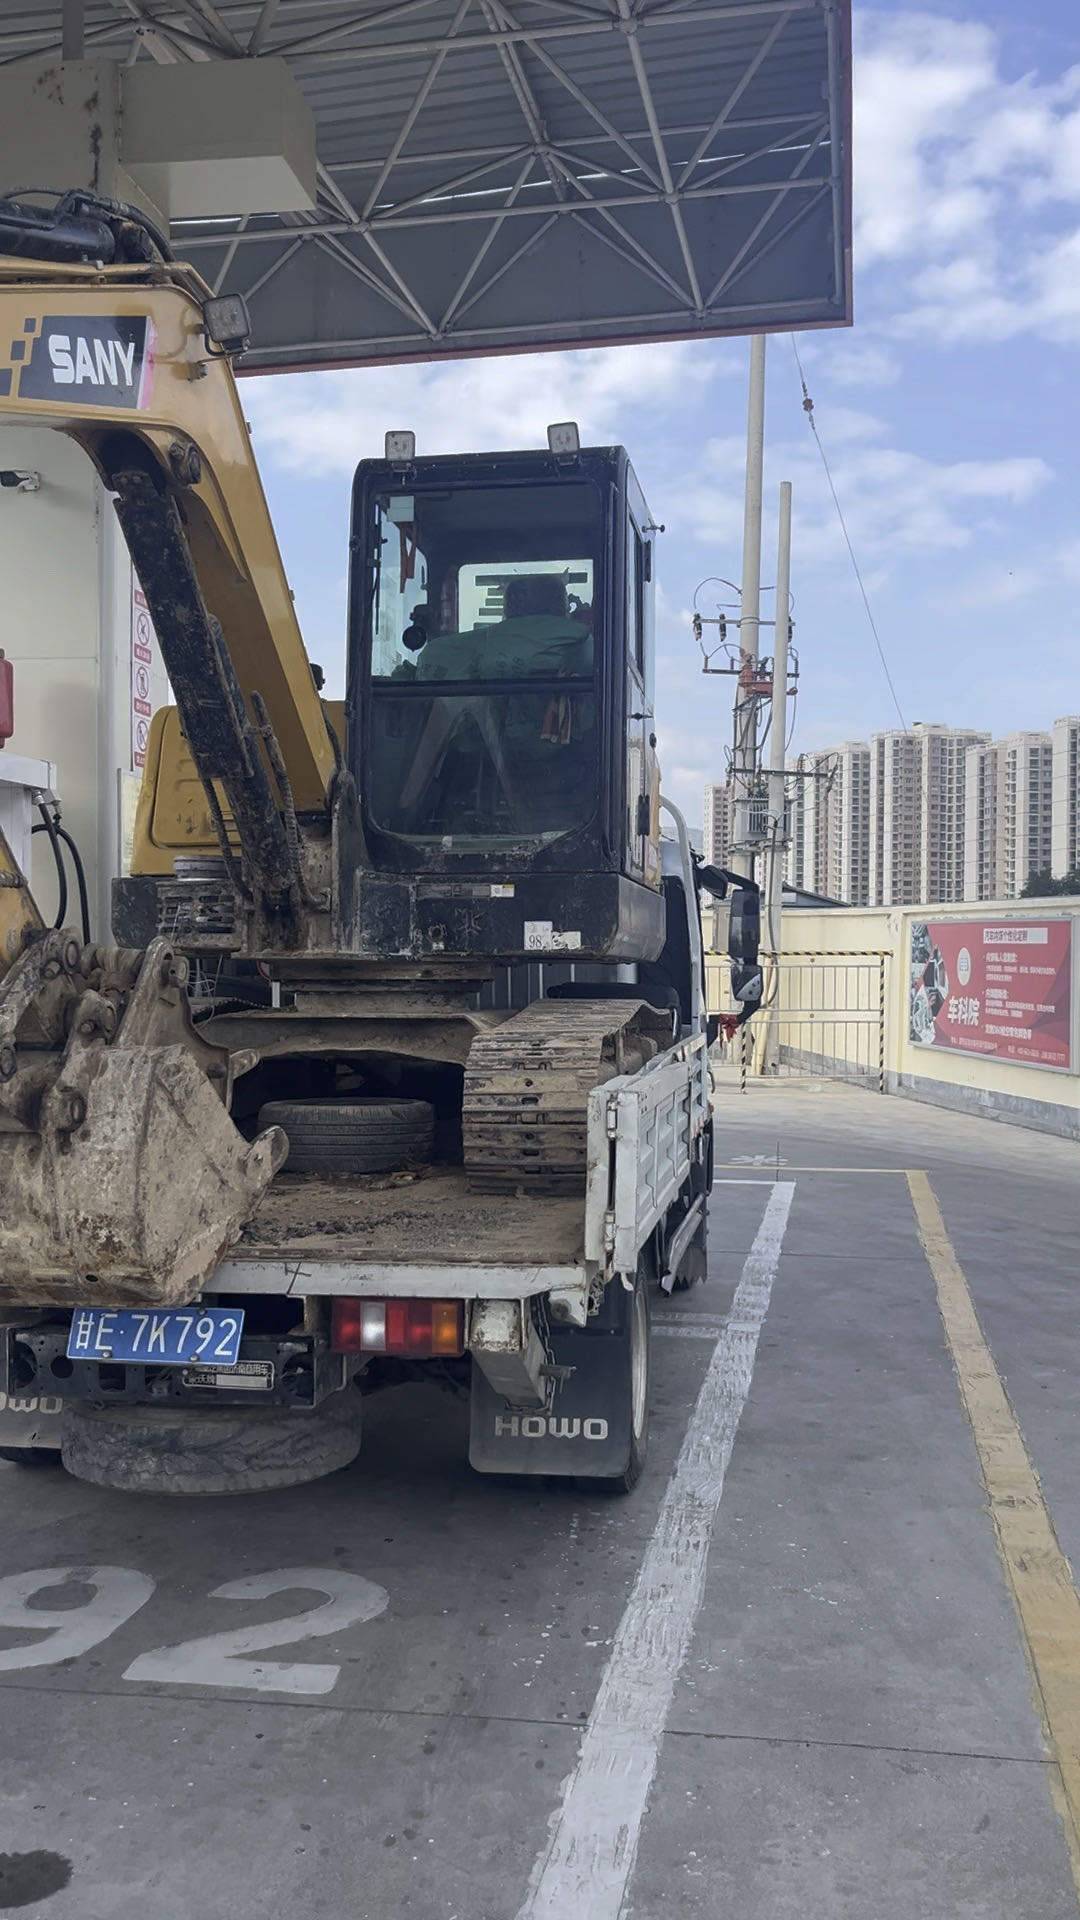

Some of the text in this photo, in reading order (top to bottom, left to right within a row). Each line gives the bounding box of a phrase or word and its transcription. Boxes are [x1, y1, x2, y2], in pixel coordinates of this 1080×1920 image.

[48, 334, 135, 386] SANY
[947, 996, 980, 1026] 车科院
[76, 1312, 237, 1357] 甘E·7K792
[0, 1391, 63, 1414] WO
[495, 1415, 608, 1440] HOWO
